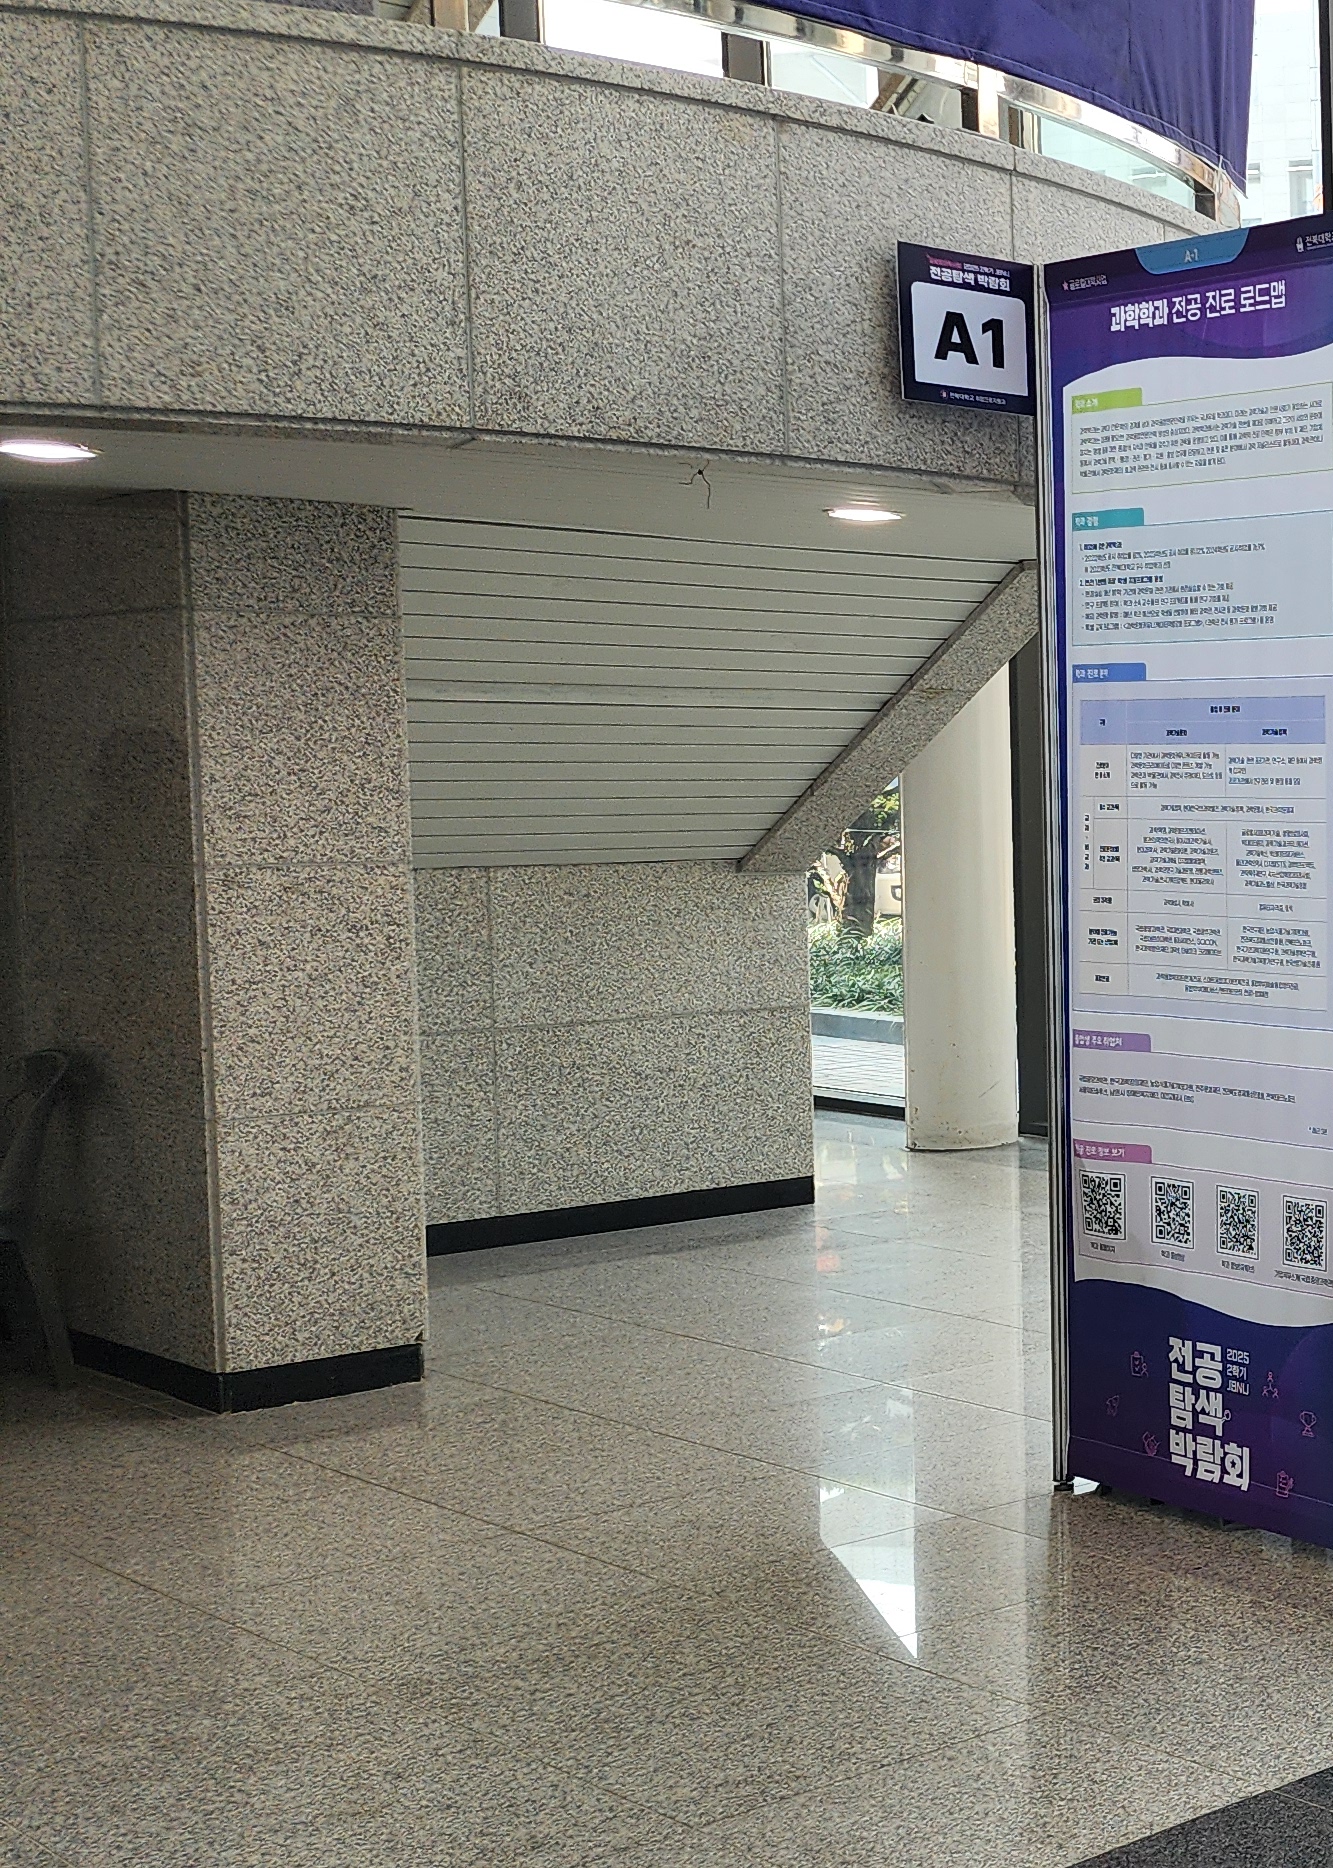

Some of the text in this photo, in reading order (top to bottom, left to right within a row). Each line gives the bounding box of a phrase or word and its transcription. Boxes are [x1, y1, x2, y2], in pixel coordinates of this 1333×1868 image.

[929, 266, 1010, 291] 전공탐색 박람회
[1110, 280, 1286, 331] 과학학과 전공 진로 로드맵
[934, 311, 1005, 369] A1
[1168, 1336, 1222, 1383] 전공
[1227, 1348, 1249, 1364] 2025
[1227, 1364, 1247, 1379] 2학기
[1169, 1383, 1223, 1436] 탐색
[1227, 1380, 1249, 1396] JBNU
[1169, 1430, 1250, 1492] 박람회
